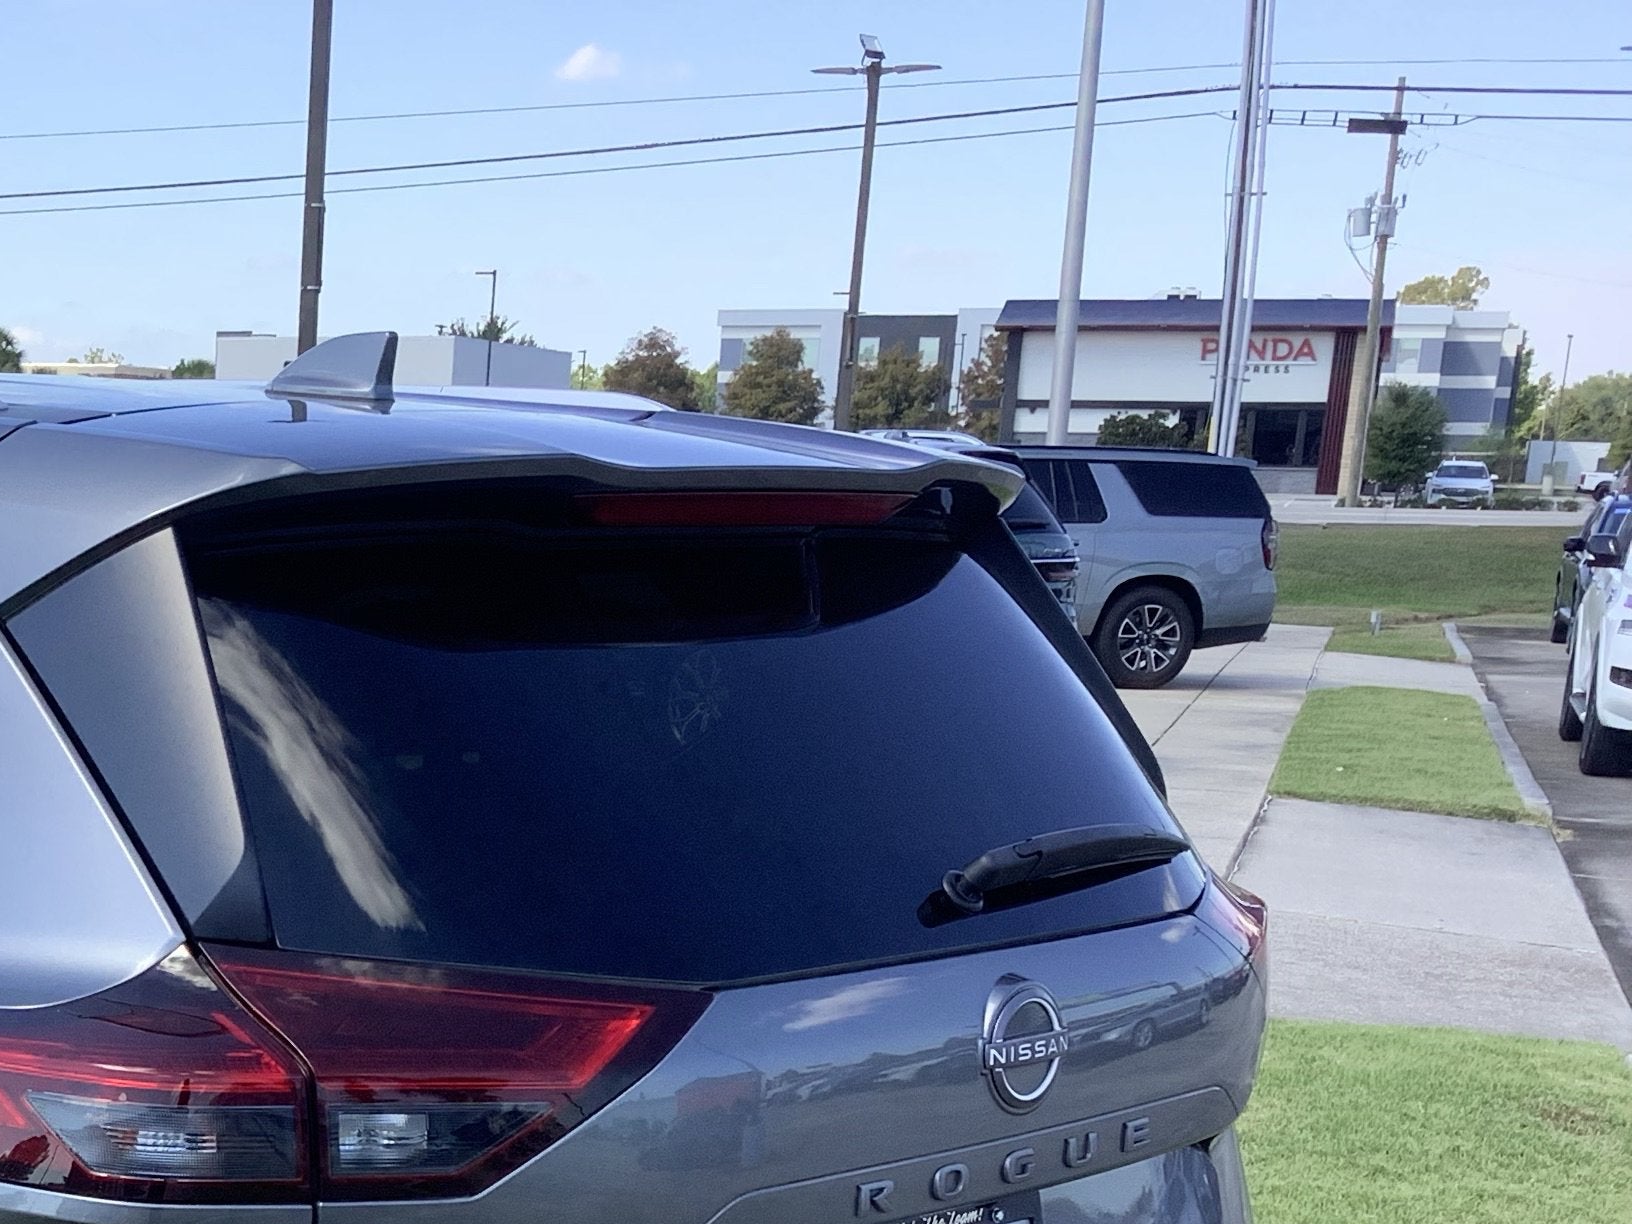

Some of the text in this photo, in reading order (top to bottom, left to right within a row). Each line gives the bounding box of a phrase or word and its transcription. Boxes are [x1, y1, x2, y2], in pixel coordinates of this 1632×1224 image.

[1200, 337, 1317, 361] PNDA
[989, 1036, 1068, 1066] NISSAN
[855, 1117, 1151, 1217] ROGUE
